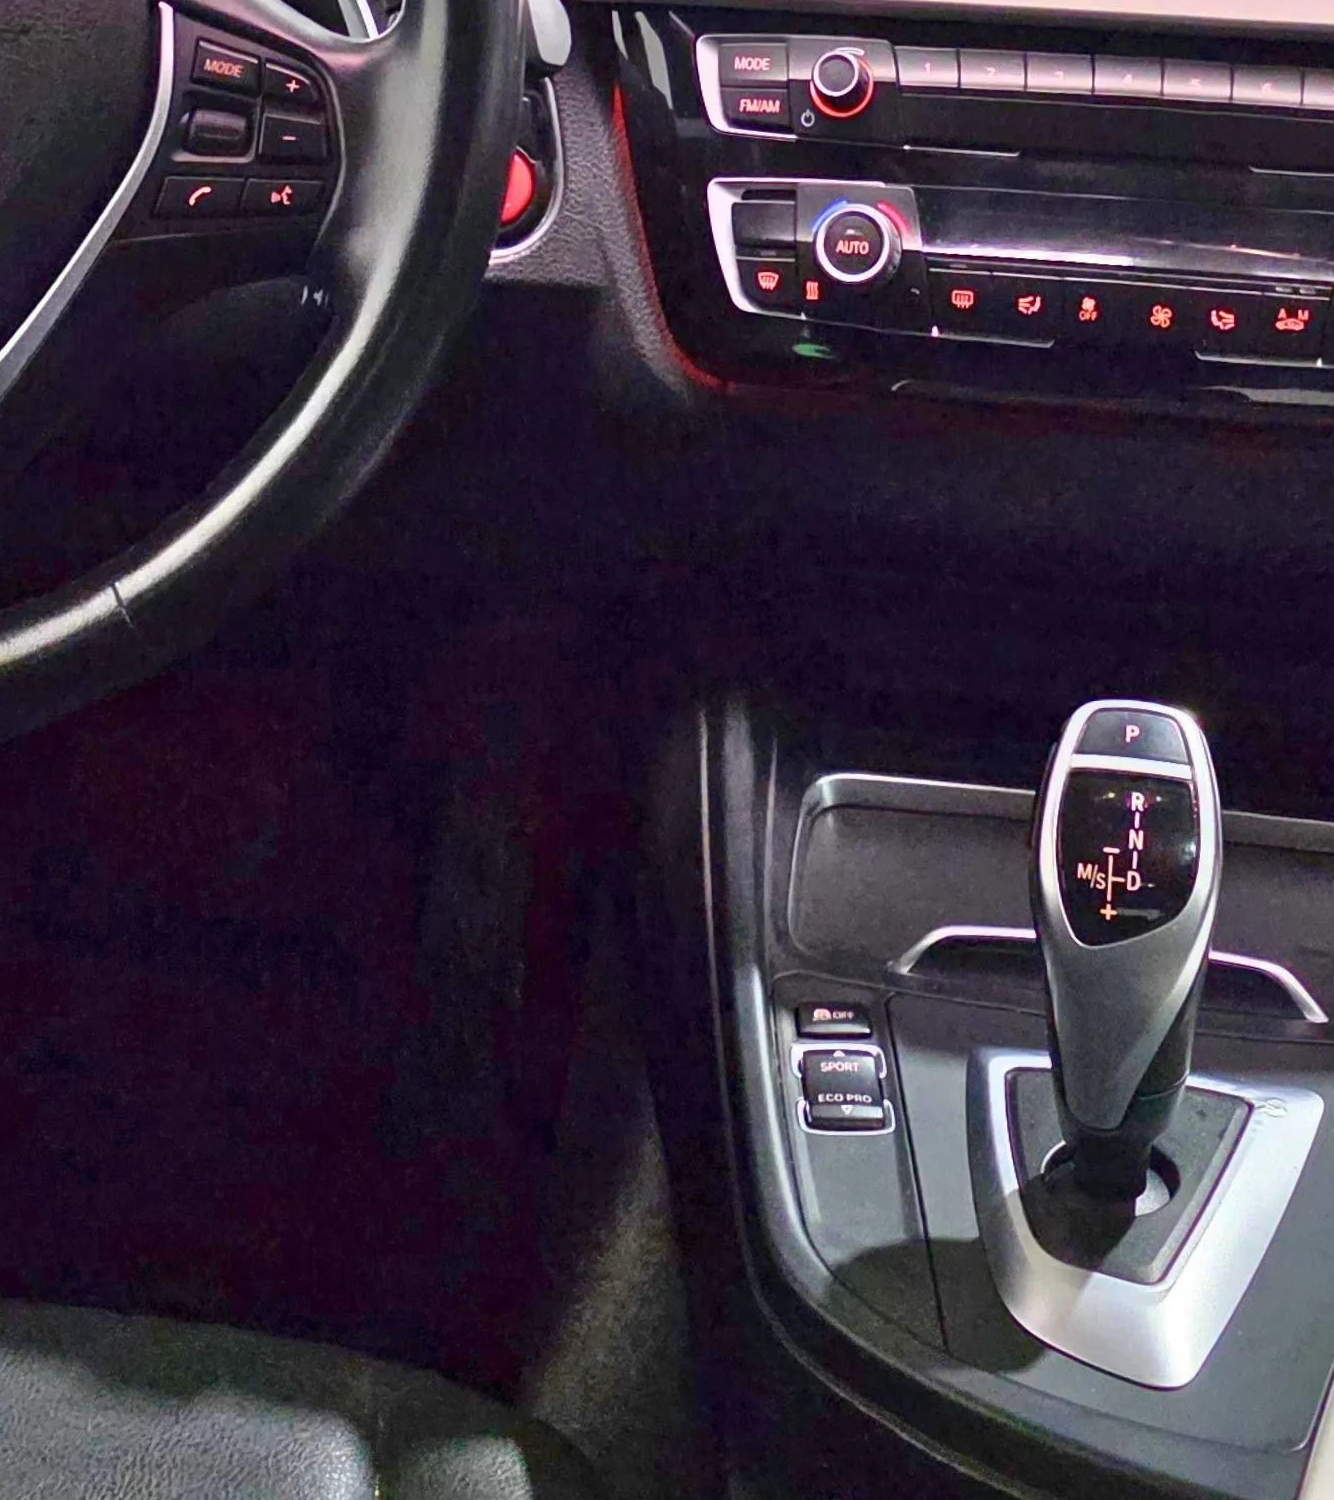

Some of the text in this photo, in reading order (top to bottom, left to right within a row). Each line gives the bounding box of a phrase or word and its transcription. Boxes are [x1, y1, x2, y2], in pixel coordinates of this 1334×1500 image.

[203, 58, 244, 79] MODE
[734, 56, 772, 71] MODE
[739, 98, 780, 113] FM/AM
[835, 240, 870, 255] AUTO
[1078, 311, 1098, 321] OFF
[1125, 725, 1140, 743] P
[1131, 791, 1146, 811] R
[1128, 829, 1144, 850] N
[1077, 863, 1107, 890] M/S
[1126, 871, 1141, 891] D
[820, 1061, 860, 1073] SPORT
[818, 1093, 872, 1104] ECO PRO
